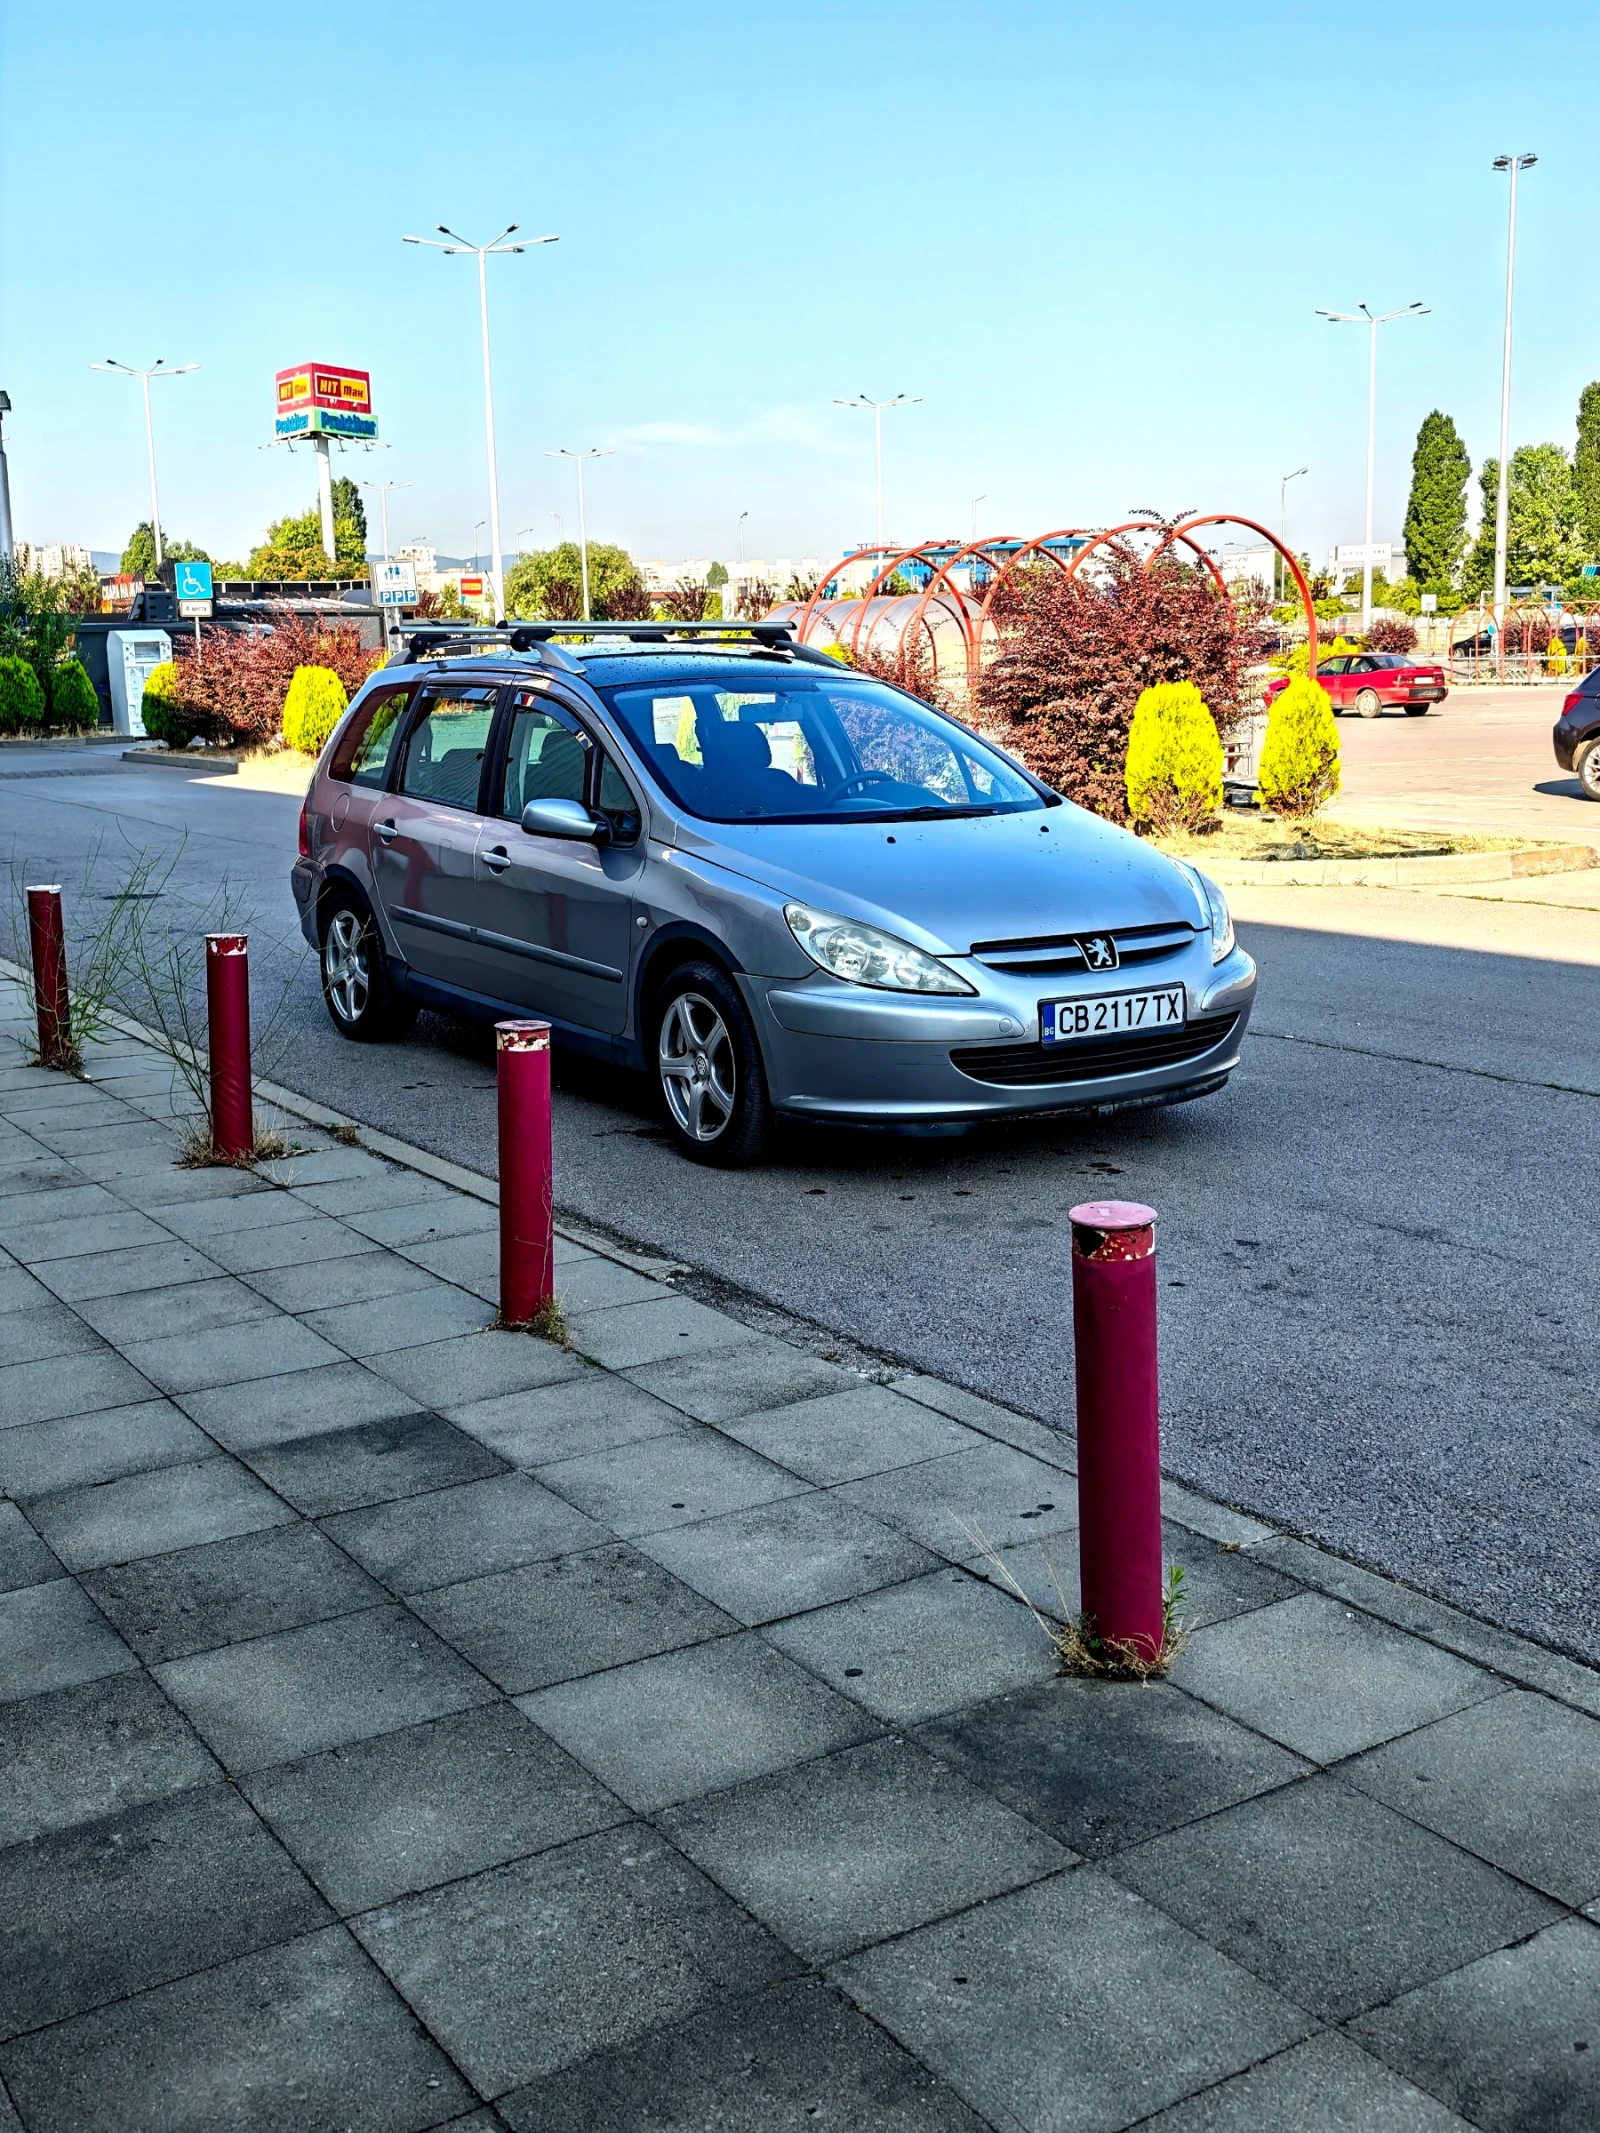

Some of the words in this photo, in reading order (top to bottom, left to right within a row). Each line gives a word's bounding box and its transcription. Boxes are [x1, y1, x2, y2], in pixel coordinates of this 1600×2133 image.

[280, 384, 292, 400] HIT
[320, 379, 338, 394] HIT
[1059, 1004, 1089, 1034] CB
[1094, 996, 1148, 1031] 2117
[1152, 992, 1180, 1022] TX
[1044, 1027, 1055, 1036] BG
